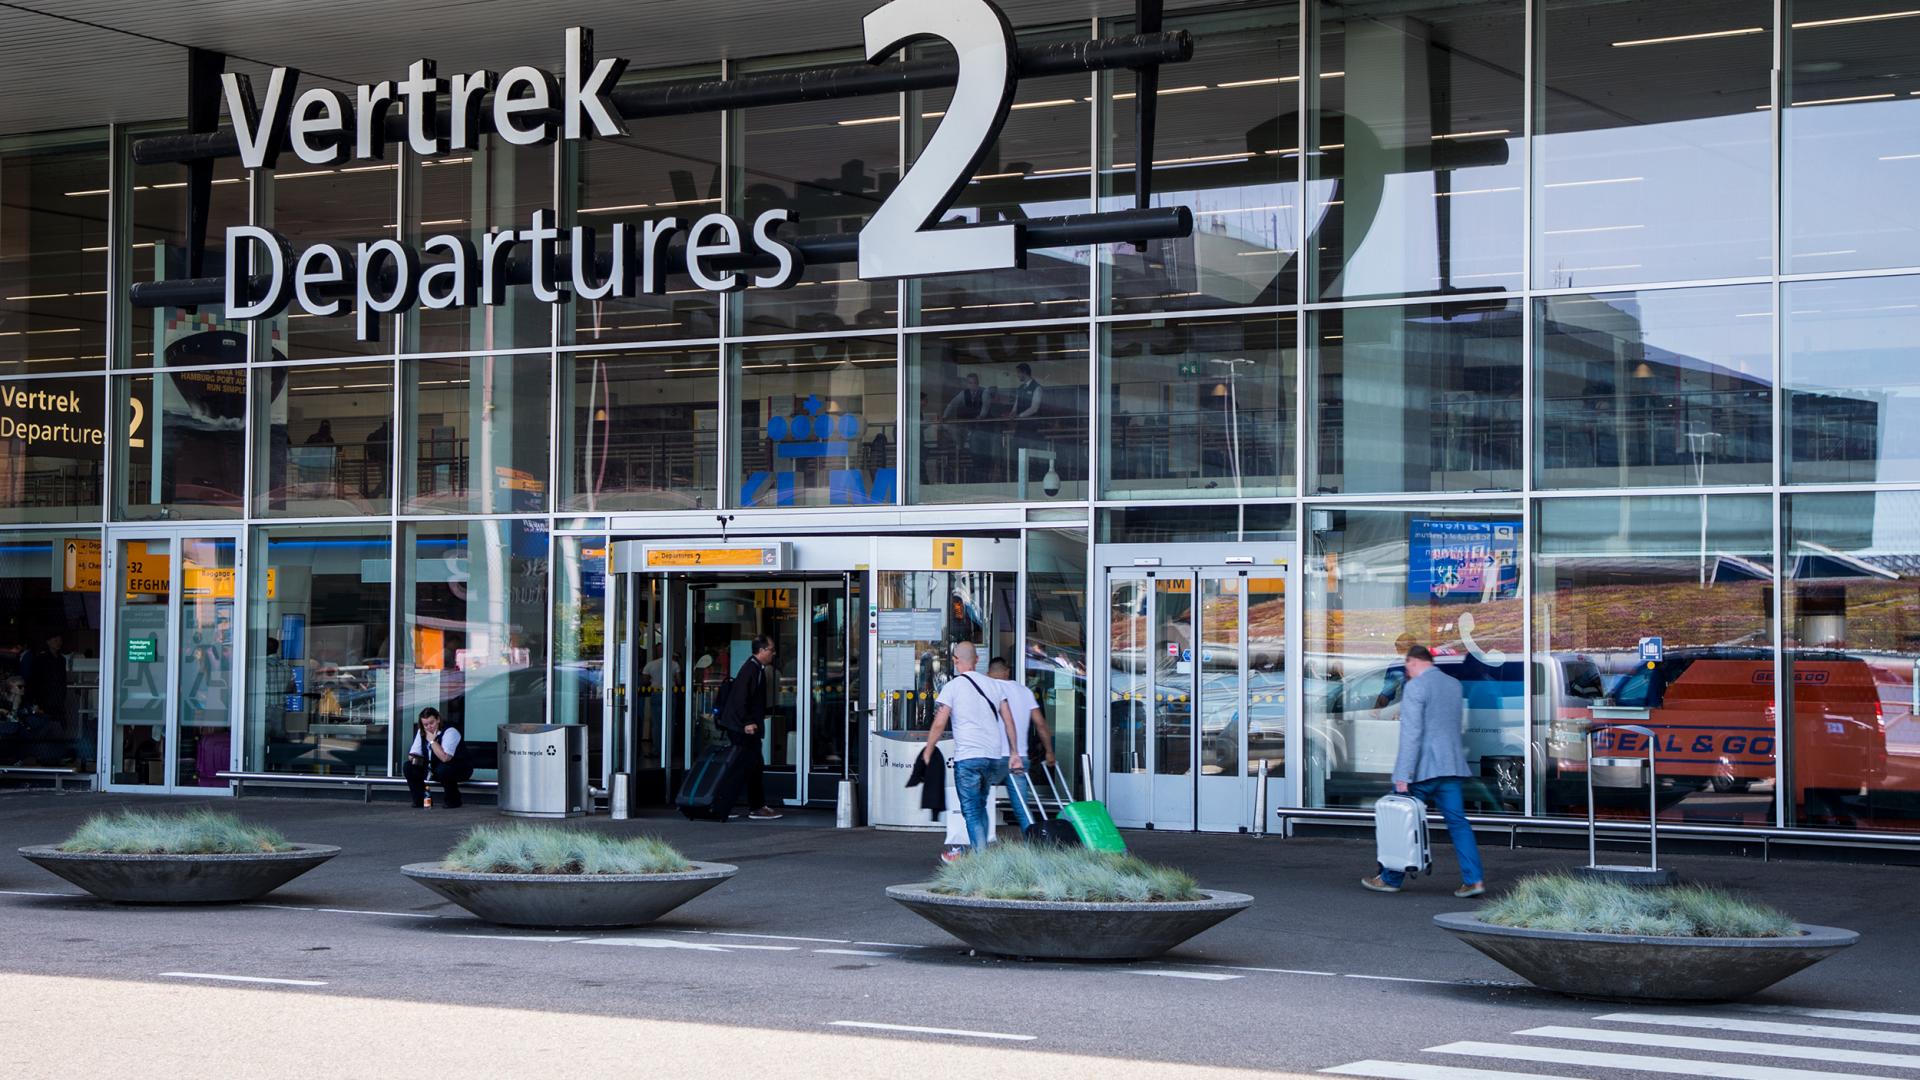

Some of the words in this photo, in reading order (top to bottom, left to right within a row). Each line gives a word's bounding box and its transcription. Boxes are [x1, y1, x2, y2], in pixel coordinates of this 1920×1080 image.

[220, 26, 622, 169] Vertrek
[858, 0, 1016, 280] 2
[224, 208, 793, 341] Departures
[181, 373, 215, 381] HAMBURG
[1, 385, 80, 413] Vertrek
[1, 416, 106, 445] Departure
[129, 397, 144, 448] 2
[661, 553, 694, 561] Departures
[695, 553, 701, 564] 2
[942, 543, 955, 565] F
[1594, 733, 1682, 753] SEAL
[1692, 735, 1713, 753] &
[1722, 736, 1776, 755] GO
